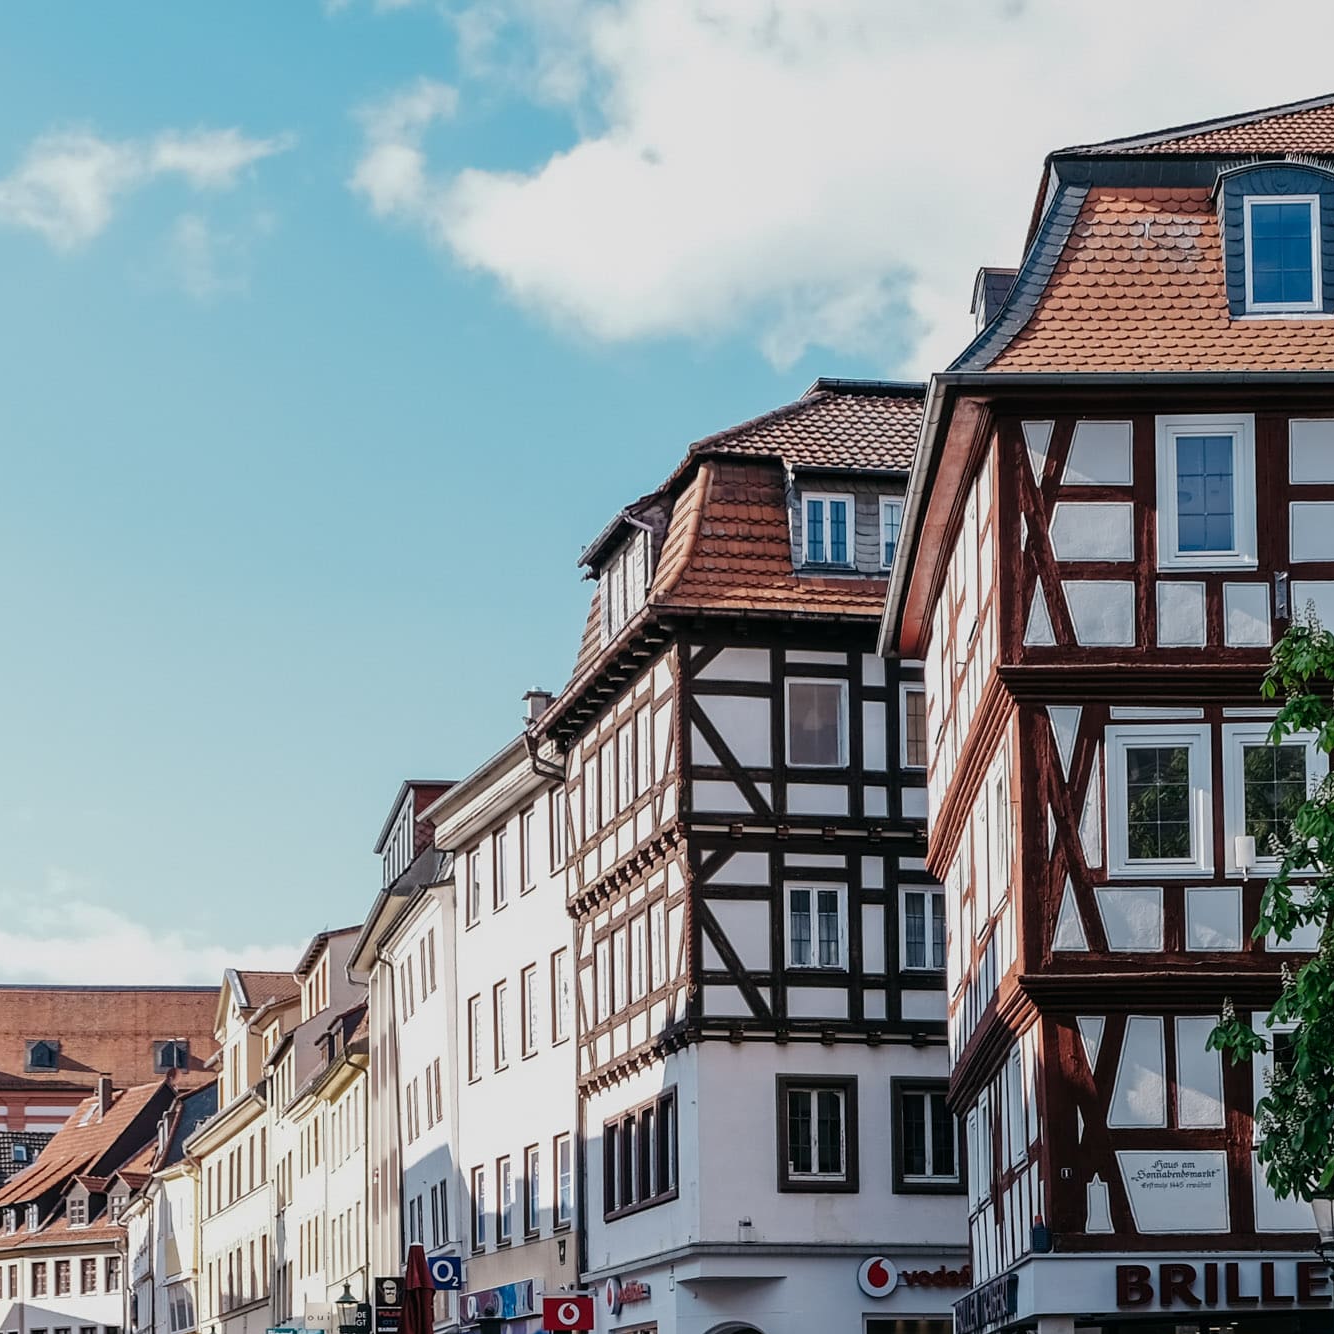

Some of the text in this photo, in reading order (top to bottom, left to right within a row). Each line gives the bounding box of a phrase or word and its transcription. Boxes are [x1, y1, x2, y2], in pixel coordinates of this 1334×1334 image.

[1181, 1161, 1196, 1169] am
[902, 1265, 971, 1287] vodaf
[357, 1311, 367, 1319] DE
[356, 1319, 366, 1327] GT
